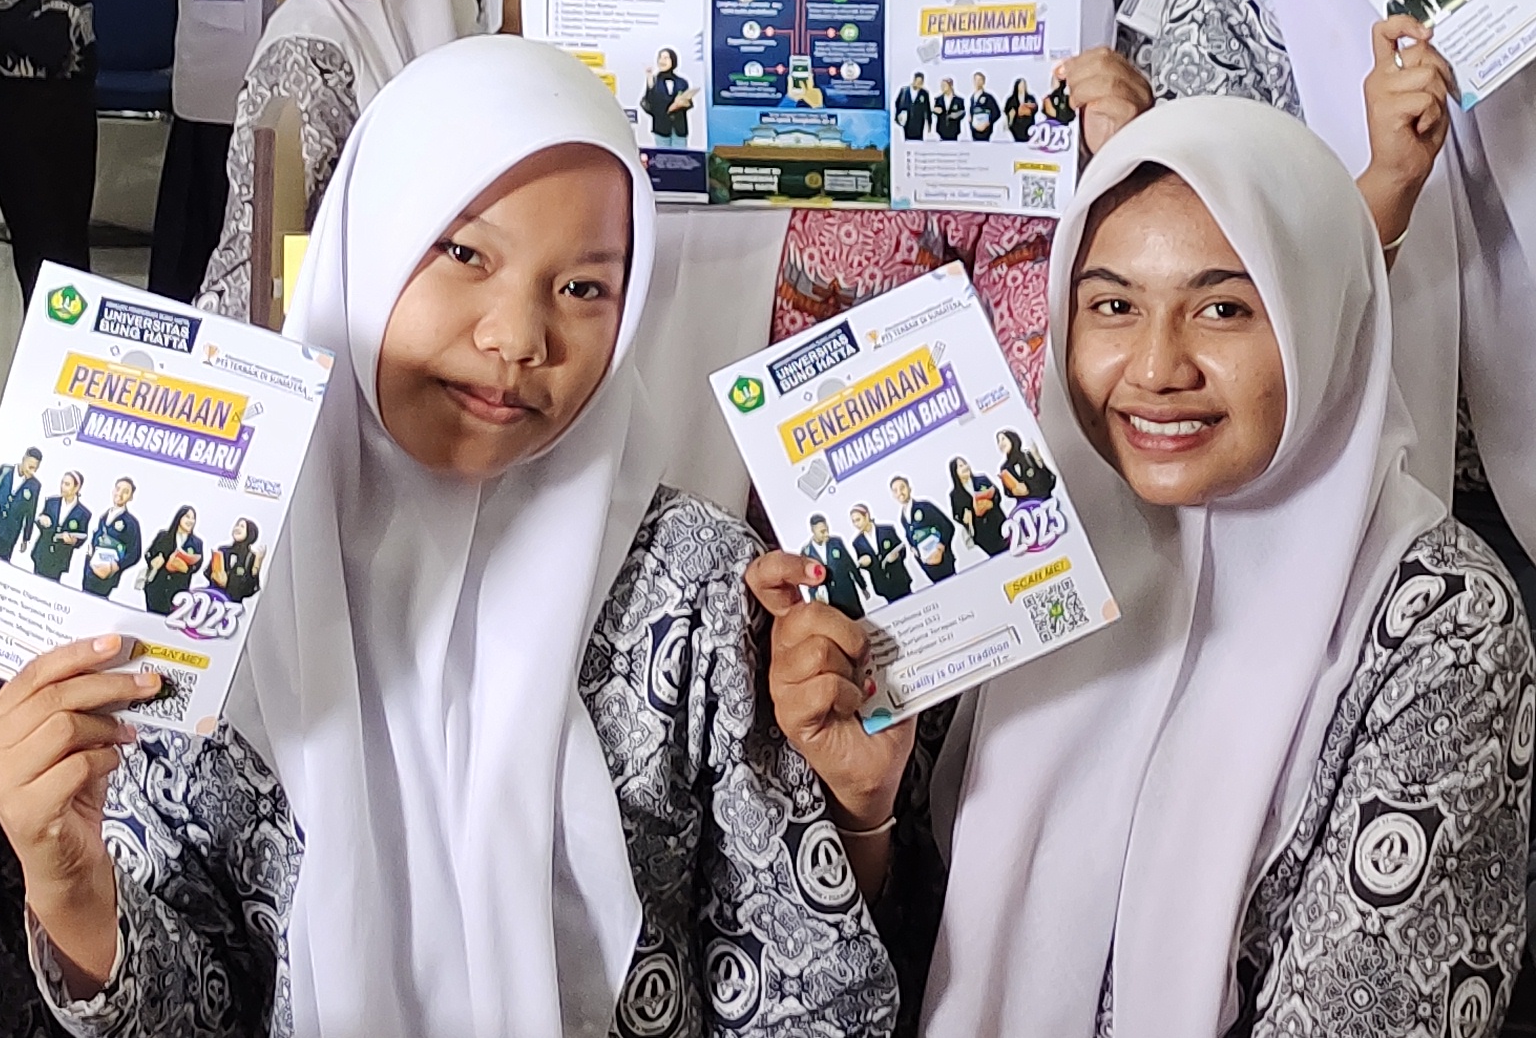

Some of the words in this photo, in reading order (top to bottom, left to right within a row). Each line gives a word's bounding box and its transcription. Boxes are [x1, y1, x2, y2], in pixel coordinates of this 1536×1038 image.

[928, 9, 1028, 33] PENERIMAAN
[944, 35, 1010, 55] MAHASISWA
[1011, 34, 1042, 53] BARU
[1028, 123, 1071, 152] 2023
[99, 319, 142, 341] BUNG
[143, 328, 189, 352] HATTA
[103, 308, 190, 339] UNIVERSITAS
[775, 332, 849, 380] UNIVERSITAS
[779, 364, 817, 390] BUNG
[816, 345, 857, 371] HATTA
[68, 364, 233, 431] PENERIMAAN
[792, 359, 931, 454] PENERIMAAN
[84, 412, 187, 461] MAHASISWA
[189, 437, 242, 471] BARU
[830, 412, 920, 476] MAHASISWA
[919, 383, 962, 432] BARU
[1002, 502, 1065, 558] 2023
[1013, 572, 1044, 592] SCAN
[164, 591, 244, 639] 2023
[901, 673, 936, 695] Quality
[947, 660, 967, 676] Our
[968, 639, 1010, 667] Tradition
